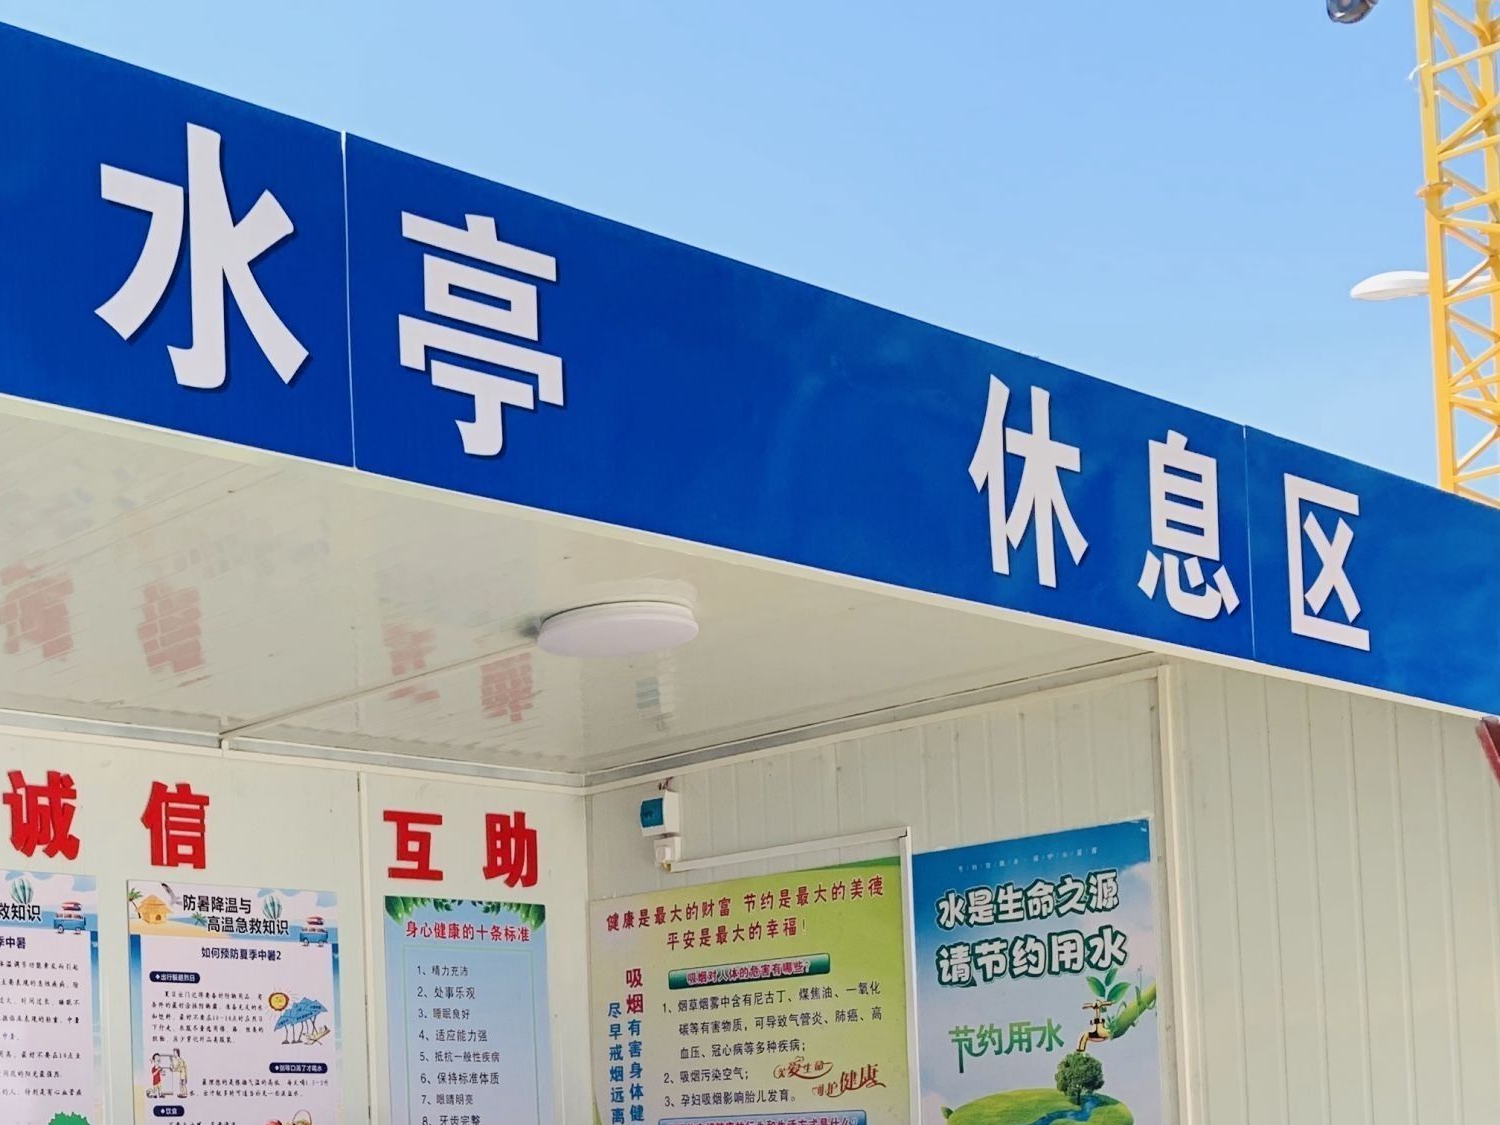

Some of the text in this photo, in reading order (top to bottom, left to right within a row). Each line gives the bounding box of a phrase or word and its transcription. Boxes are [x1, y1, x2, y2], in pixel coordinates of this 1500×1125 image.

[968, 374, 1370, 651] 休息区
[3, 769, 210, 870] 诚信
[383, 810, 538, 888] 互助
[182, 894, 252, 914] 防暑降温与
[606, 875, 884, 932] 健康是最大的财富 节约是最大的美德
[936, 868, 1120, 929] 水是生命之源
[206, 915, 289, 936] 高温急救知识
[405, 920, 531, 943] 身心健康的十条标准
[667, 916, 807, 951] 平安是最大的幸福！
[201, 946, 282, 962] 如何预防夏季中暑2
[937, 925, 1129, 987] 请节约用水
[417, 964, 469, 977] 1、精力充沛
[687, 960, 812, 986] 吸烟对人体的危害有哪些？
[417, 986, 476, 1000] 2、处事乐观
[663, 981, 882, 1014] 1、烟草烟雾中含有尼古丁、煤焦油、一氧化
[678, 1006, 883, 1036] 碳等有害物质，可导致气管炎、肺癌、高
[418, 1029, 489, 1042] 4、适应能力强
[949, 1018, 1065, 1074] 节约用水
[419, 1051, 501, 1064] 5、抵抗一般性疾病
[680, 1038, 806, 1060] 血压、冠心病等多种疾病；
[420, 1072, 500, 1085] 6、保持标准体质
[664, 1065, 750, 1085] 2、吸烟污染空气；
[421, 1093, 475, 1106] 7、眼睛明亮
[664, 1088, 797, 1108] 3、孕妇吸烟影响胎儿发育。
